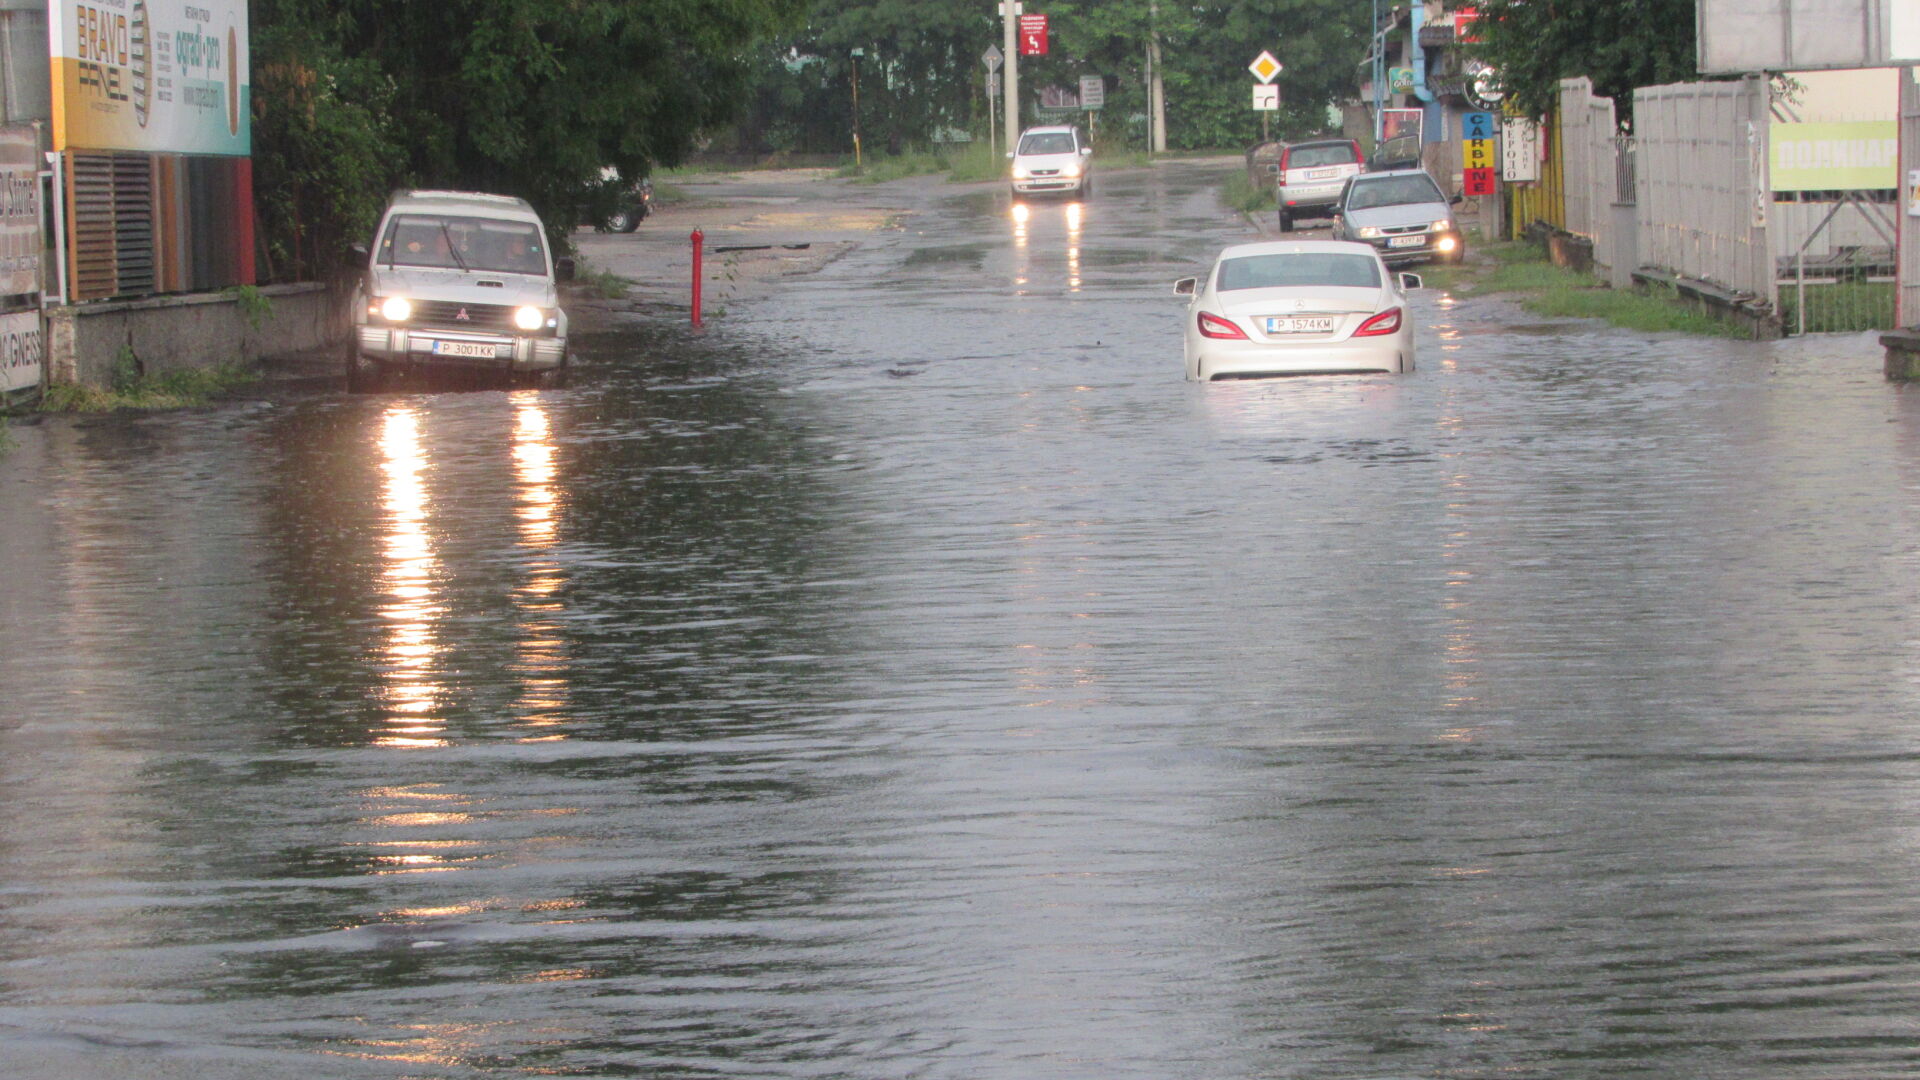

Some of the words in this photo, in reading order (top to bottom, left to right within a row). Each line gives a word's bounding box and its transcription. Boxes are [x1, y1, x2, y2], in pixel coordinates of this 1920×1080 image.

[77, 5, 128, 66] BRAVO
[8, 171, 34, 217] Stone
[1278, 319, 1285, 330] P
[443, 343, 450, 353] P
